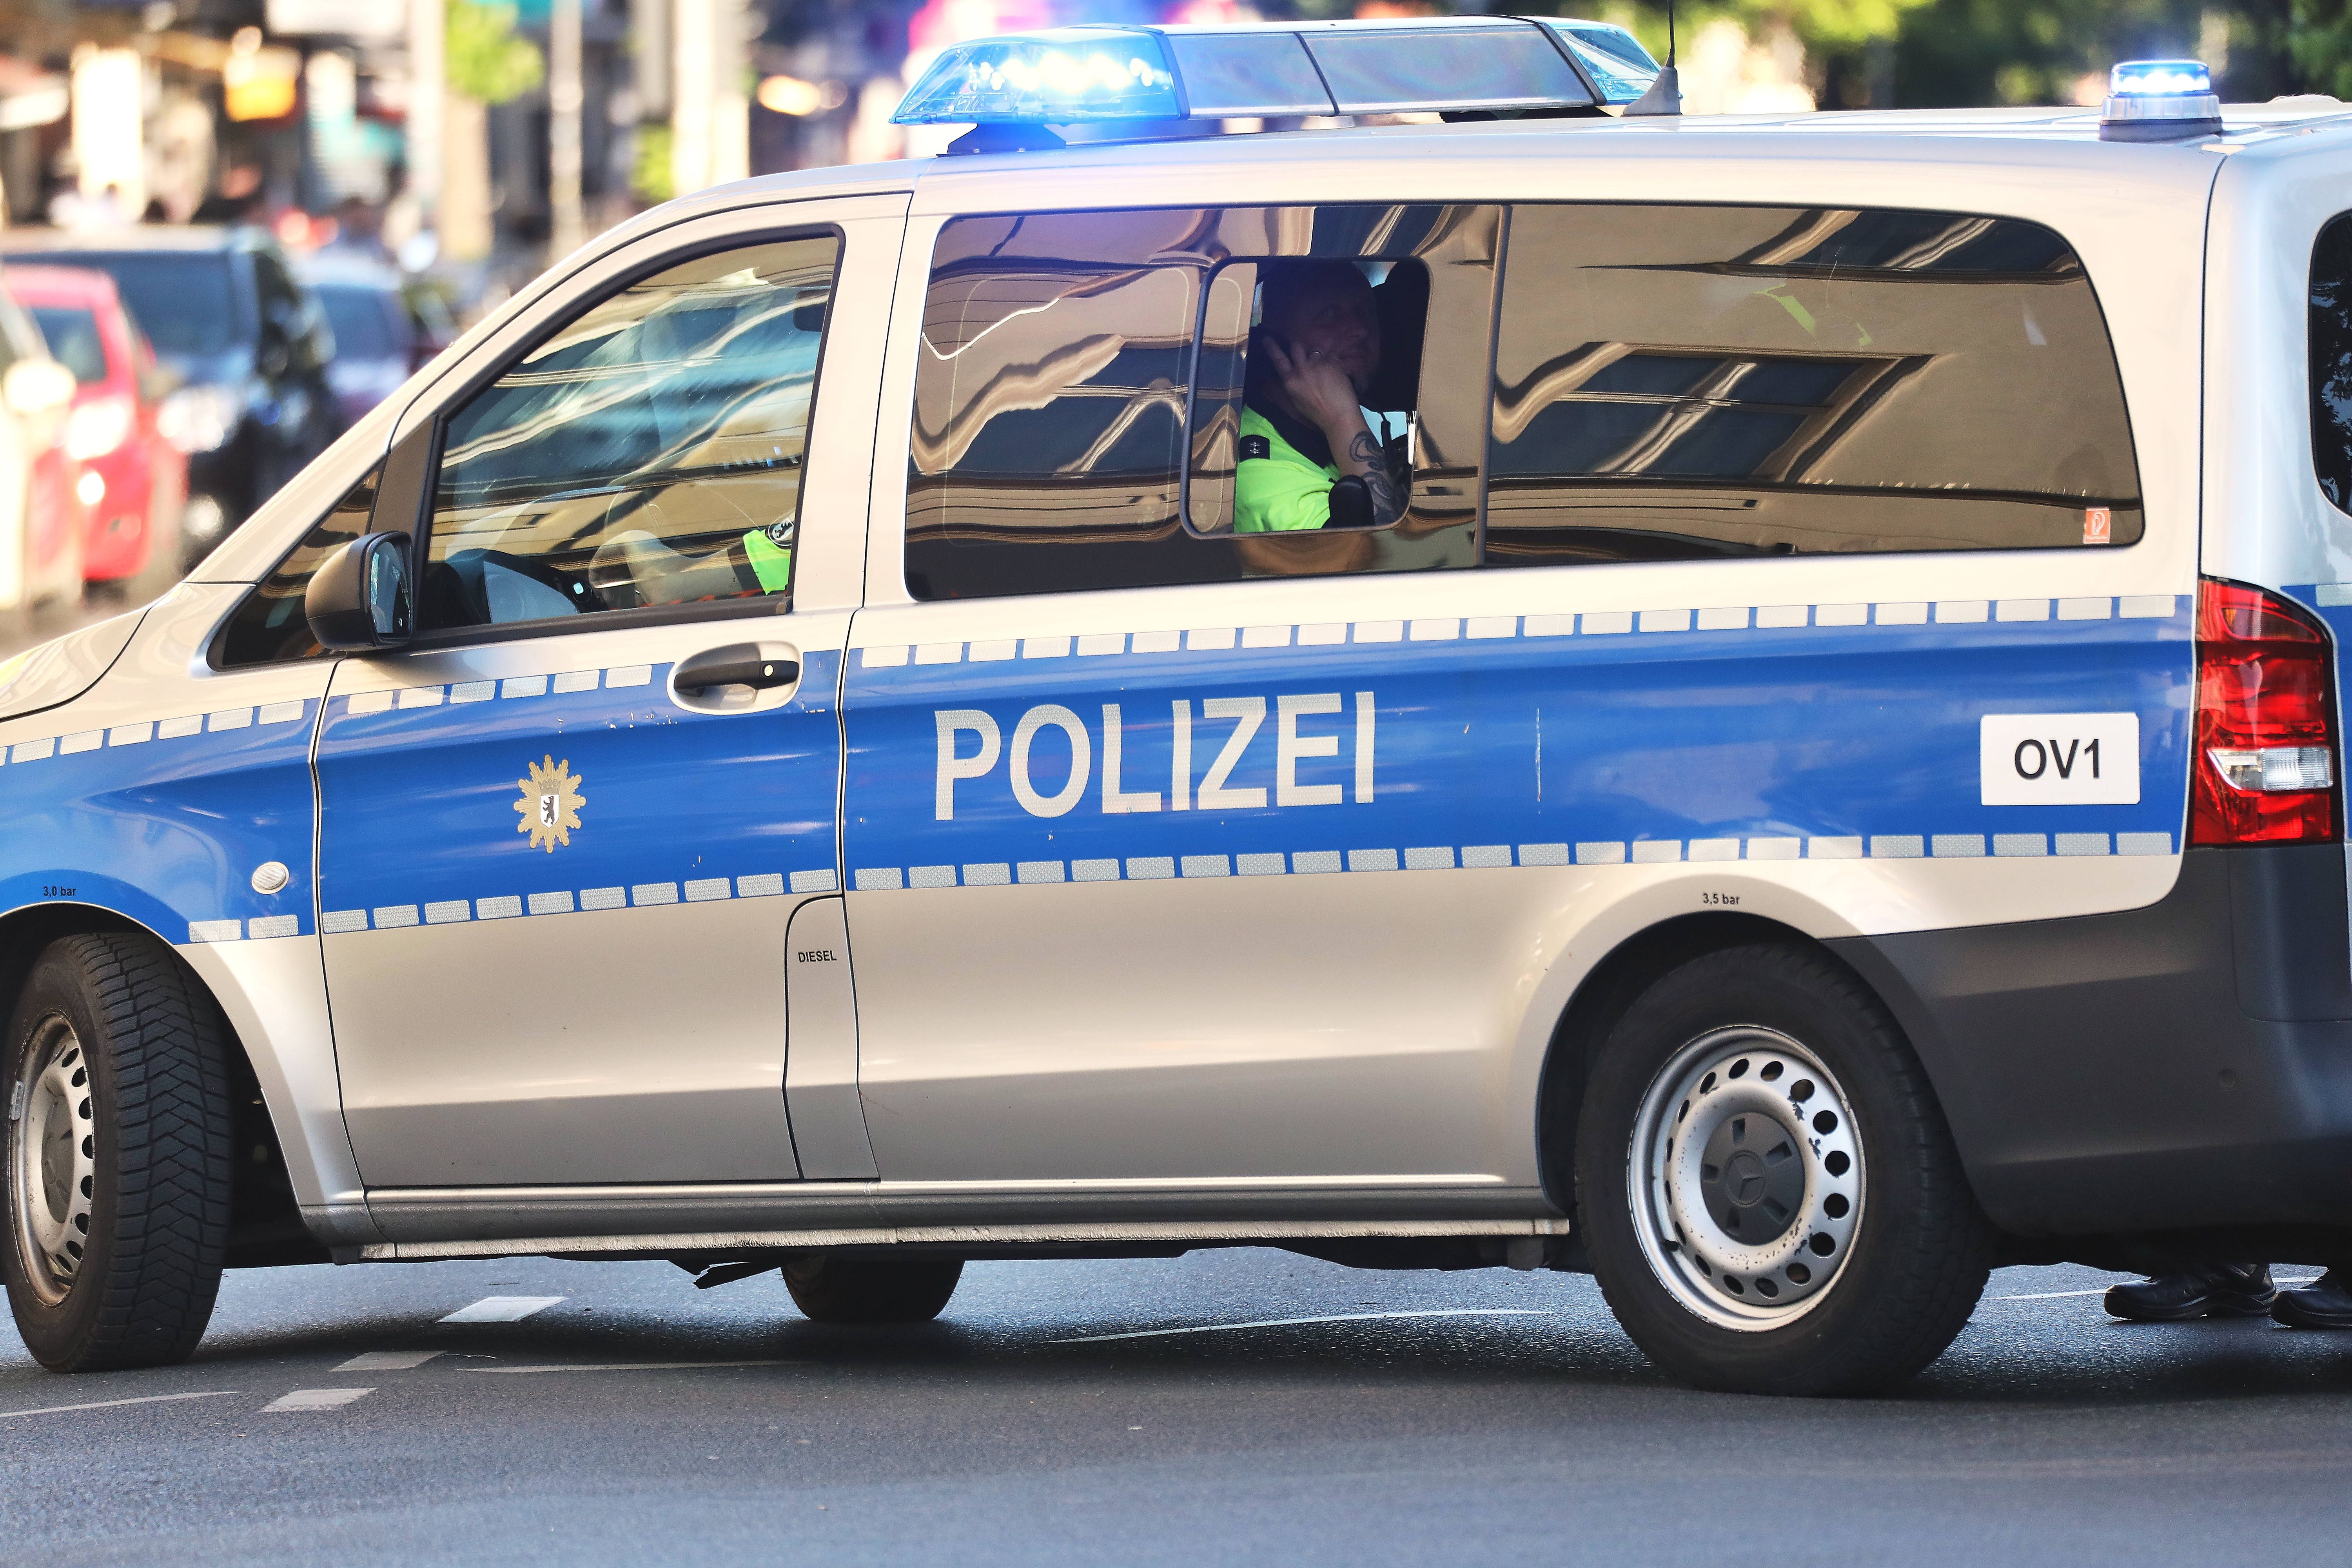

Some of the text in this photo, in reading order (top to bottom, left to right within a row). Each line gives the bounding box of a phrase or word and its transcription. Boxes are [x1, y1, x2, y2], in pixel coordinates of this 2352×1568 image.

[935, 691, 1376, 821] POLIZEI
[2014, 738, 2100, 780] OV1
[43, 886, 77, 898] 3,0 bar
[1702, 892, 1741, 906] 3,5 bar
[797, 950, 838, 963] DIESEL
